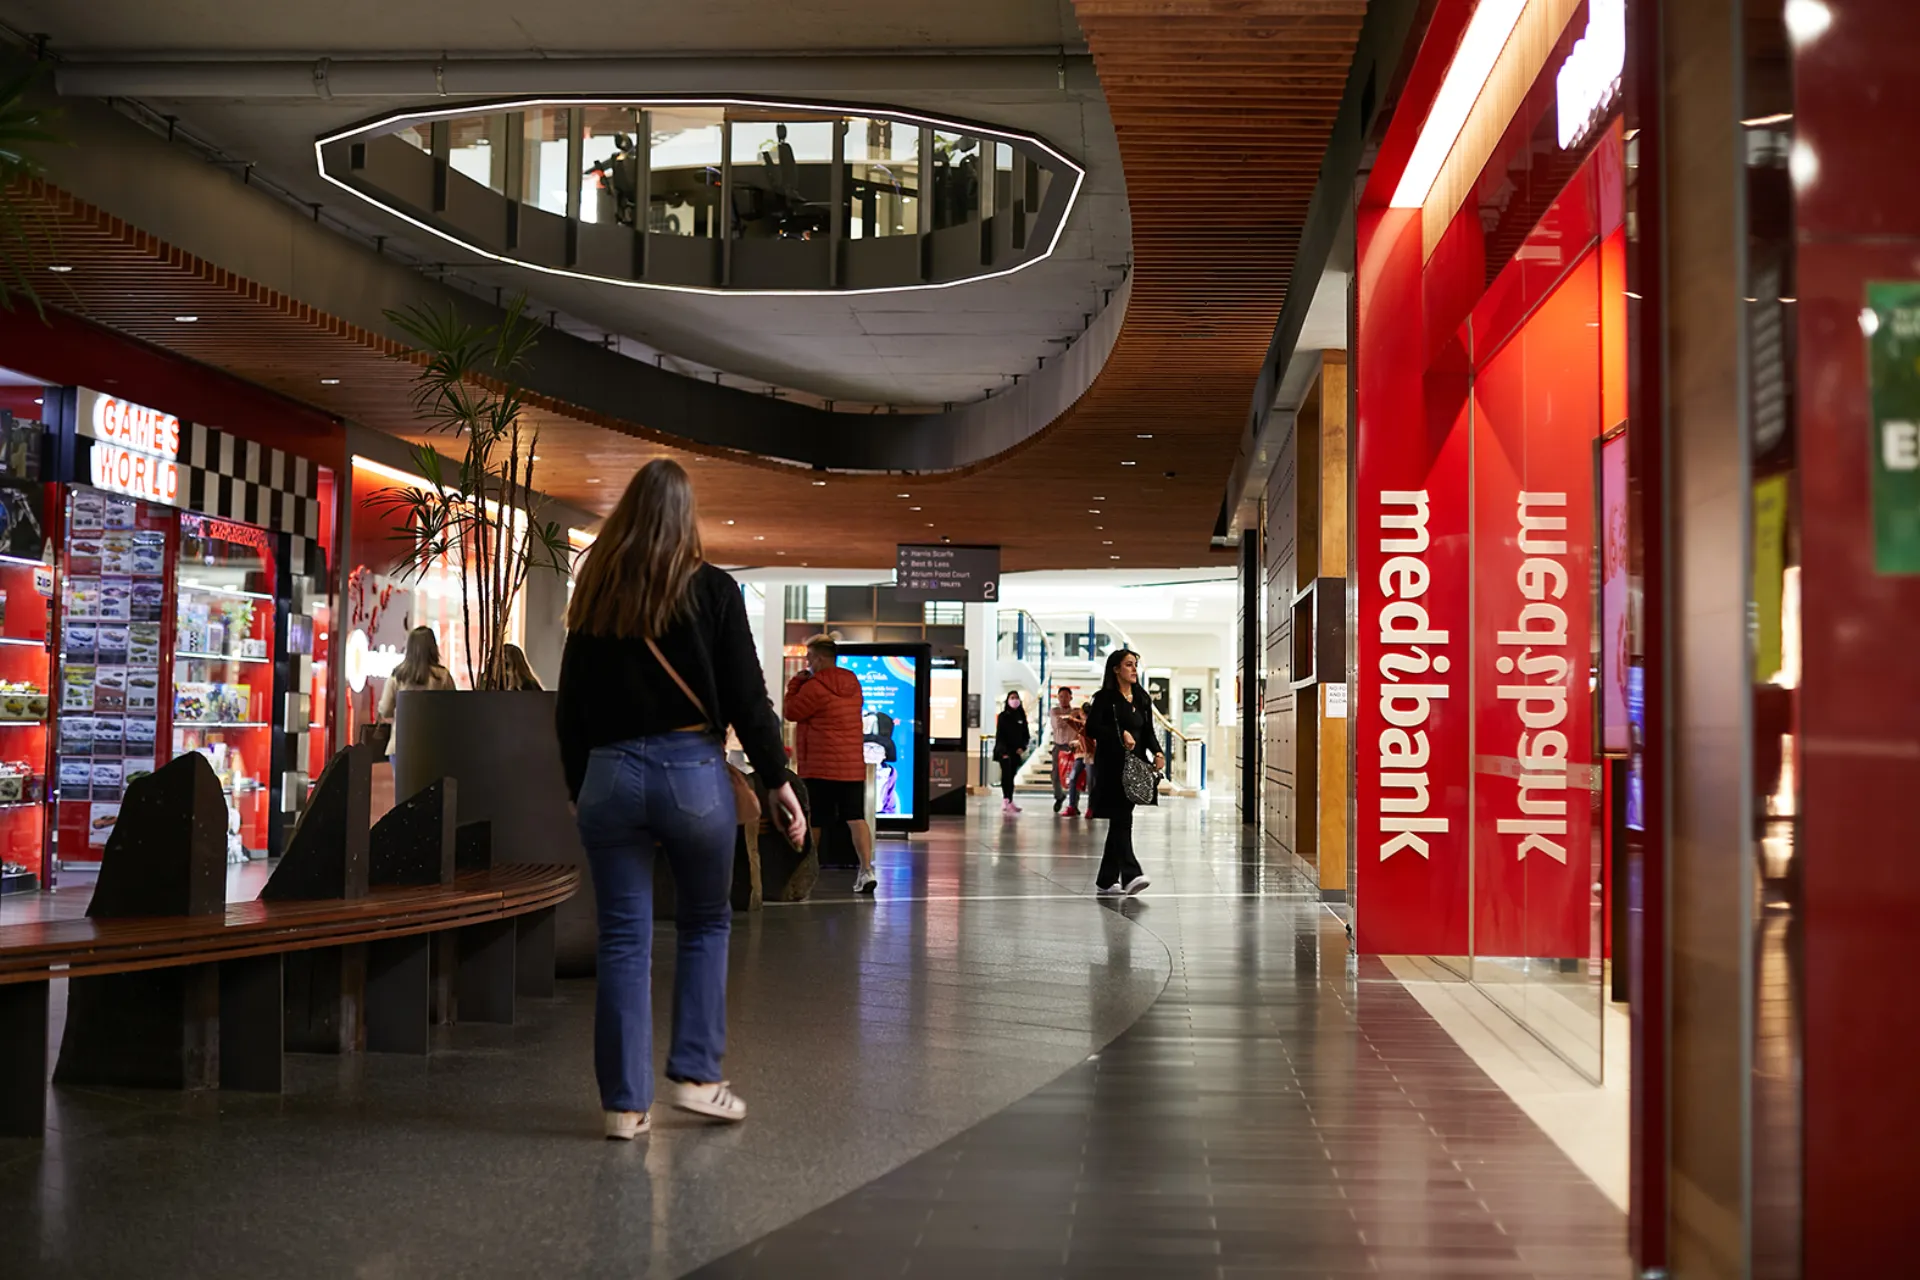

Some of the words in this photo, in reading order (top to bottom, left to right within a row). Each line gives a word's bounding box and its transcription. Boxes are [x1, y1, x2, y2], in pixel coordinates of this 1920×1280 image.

[103, 399, 180, 455] GAMES
[100, 445, 179, 499] WORLD
[983, 581, 995, 599] 2
[1378, 488, 1450, 862] medibank
